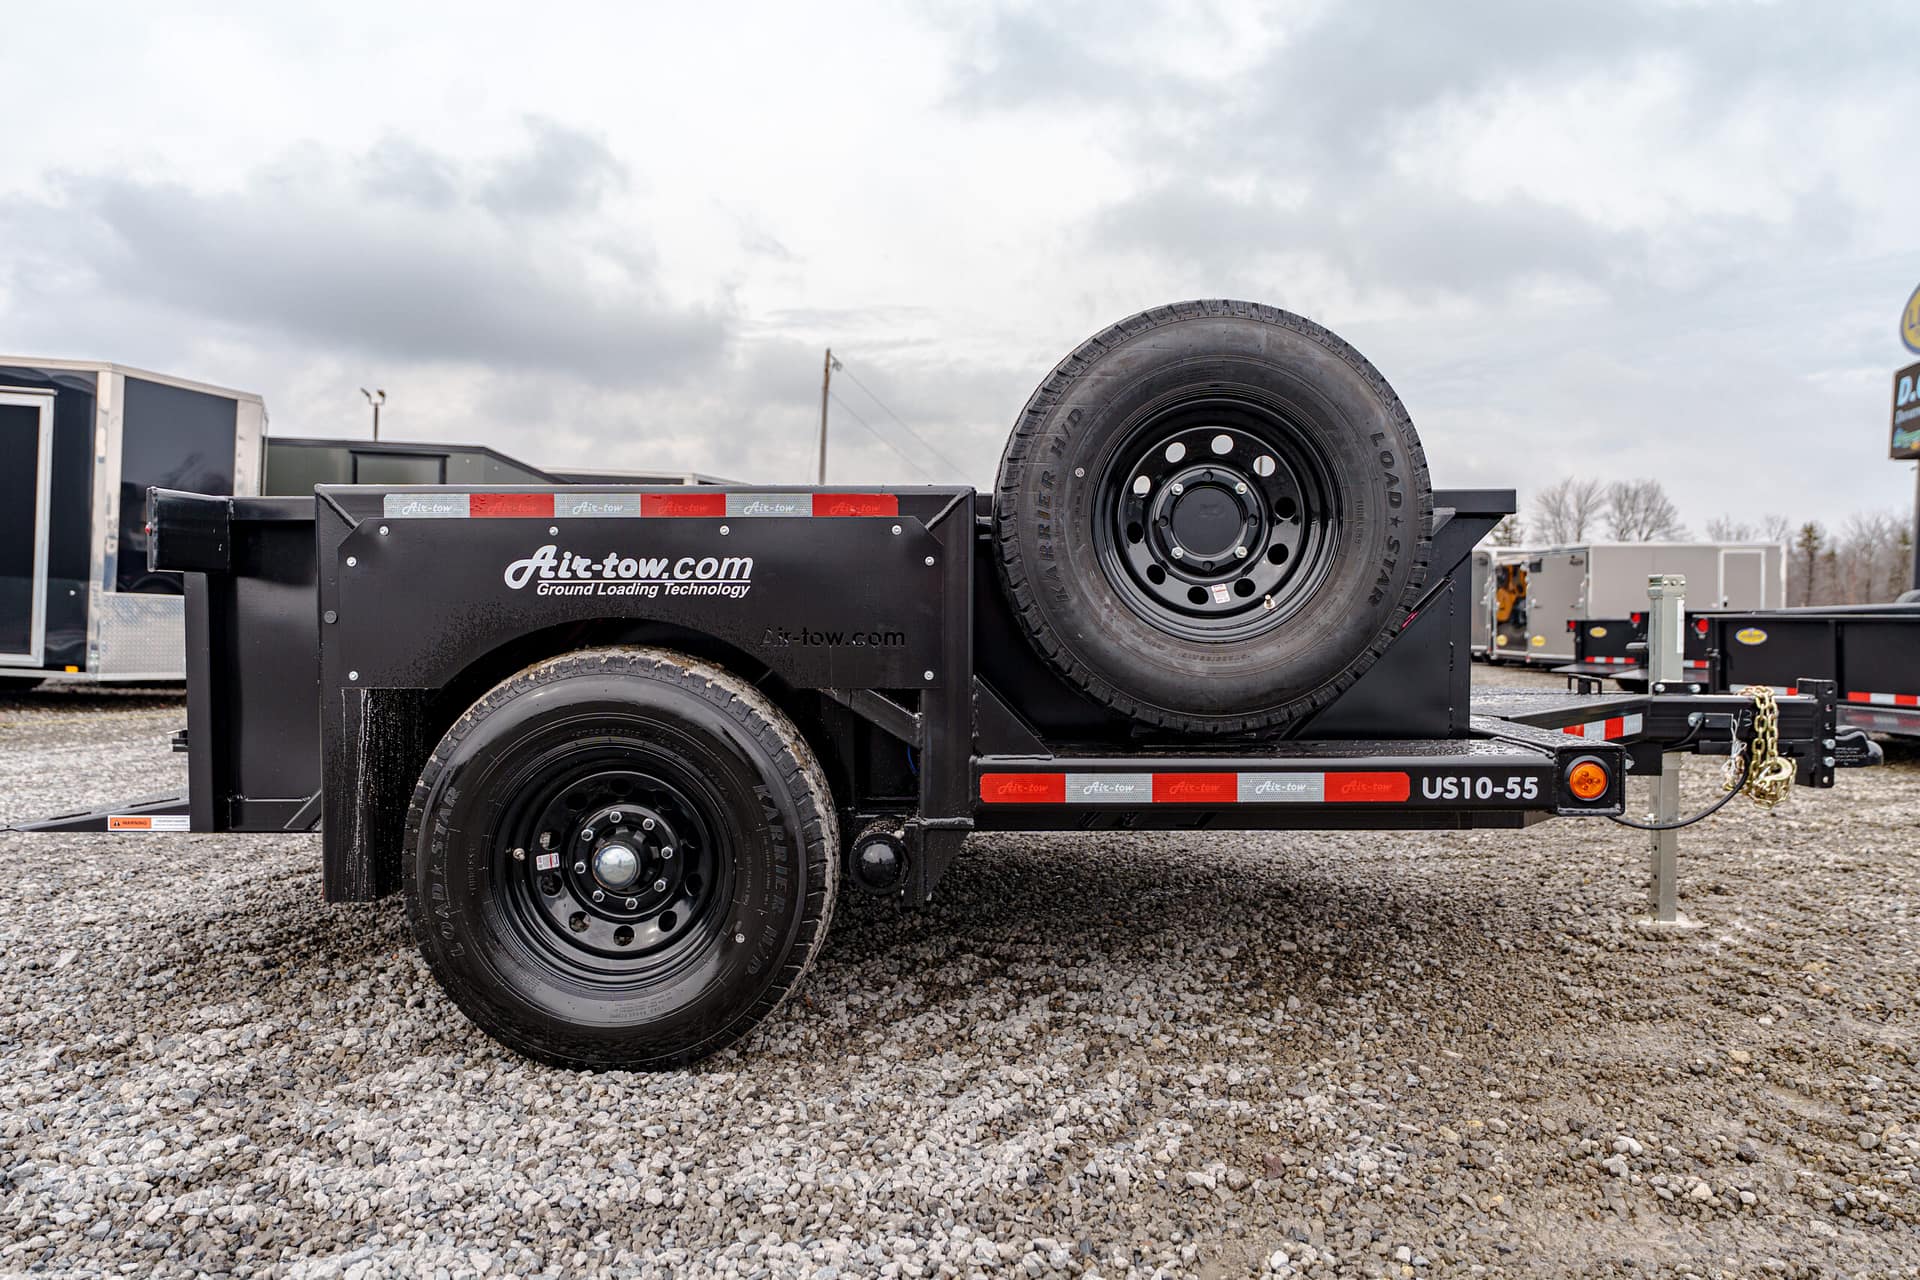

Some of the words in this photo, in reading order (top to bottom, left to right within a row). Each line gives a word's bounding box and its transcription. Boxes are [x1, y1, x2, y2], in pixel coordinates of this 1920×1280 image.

[1369, 432, 1403, 510] LOAD
[402, 502, 452, 515] Air-tow
[572, 502, 623, 515] Air-tow
[743, 501, 795, 515] Air-tow
[1037, 470, 1074, 602] KARRIER
[503, 544, 754, 590] Air-tow.com
[1368, 535, 1401, 607] STAR
[536, 583, 594, 597] Ground
[597, 583, 659, 599] Loading
[664, 583, 751, 599] Technology
[759, 625, 906, 648] Air-tow.com
[1083, 780, 1135, 795] Air-tow
[1255, 780, 1306, 795] Air-tow
[1422, 776, 1539, 800] US10-55
[751, 784, 788, 914] KARRIER
[431, 883, 466, 958] LOAD
